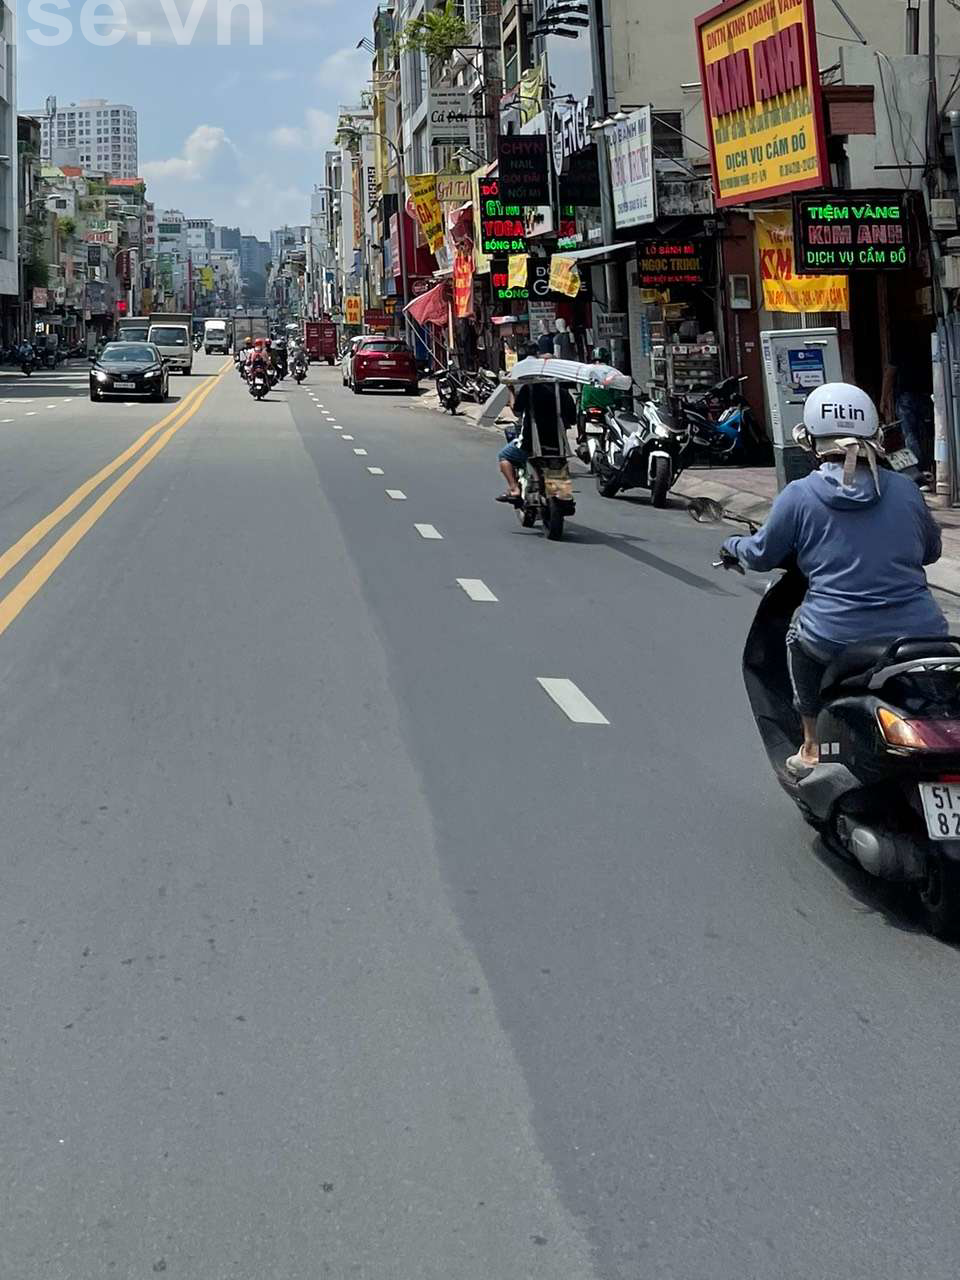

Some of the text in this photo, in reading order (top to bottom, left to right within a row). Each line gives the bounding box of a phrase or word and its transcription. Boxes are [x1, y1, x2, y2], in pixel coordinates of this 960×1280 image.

[726, 14, 747, 40] KINH
[747, 0, 776, 30] DOANH
[705, 22, 807, 118] KIM ANH
[725, 149, 749, 173] DỊCH
[750, 145, 764, 167] VỤ
[808, 203, 900, 221] TIỆM VÀNG
[808, 224, 903, 245] KIM ANH
[807, 251, 835, 266] DỊCH
[839, 251, 854, 266] VỤ
[821, 403, 865, 422] Fit in
